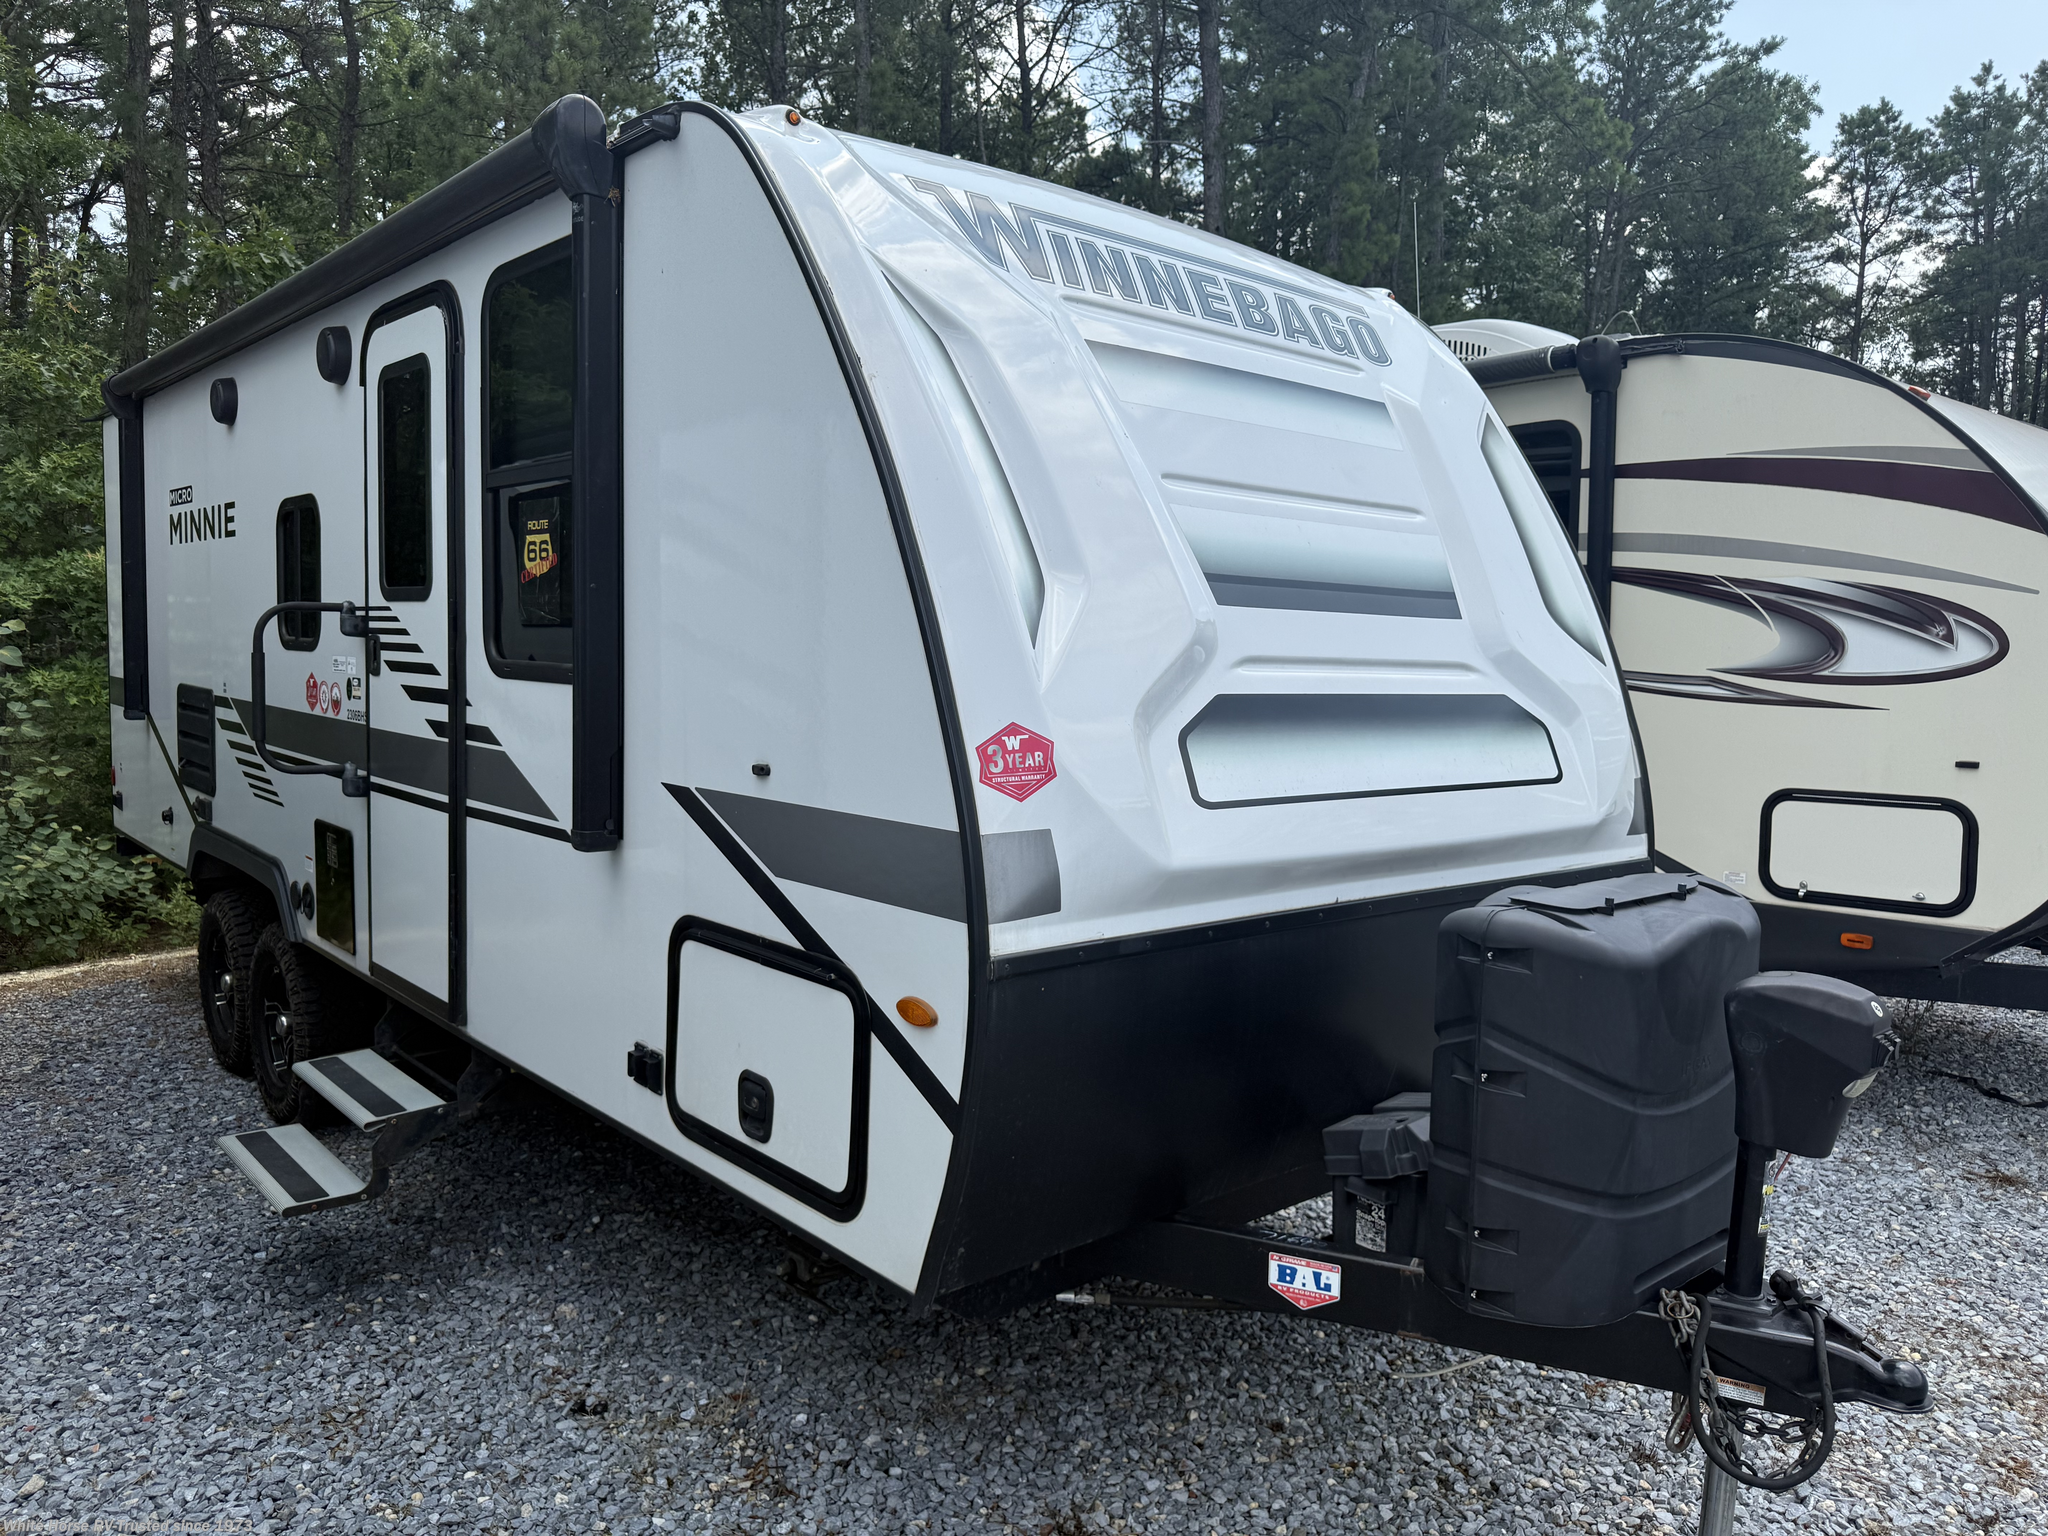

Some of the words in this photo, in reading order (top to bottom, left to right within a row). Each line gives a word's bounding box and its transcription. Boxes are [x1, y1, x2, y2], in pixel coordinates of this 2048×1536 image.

[905, 176, 1392, 367] WINNEBAGO
[170, 488, 192, 505] MICRO
[169, 501, 236, 545] MINNIE
[528, 520, 548, 530] ROUTE
[527, 540, 550, 562] 66
[521, 553, 558, 583] CERTIFIED
[987, 745, 1004, 773] 3
[1005, 752, 1044, 768] YEAR
[992, 775, 1021, 783] STRUCTURAL
[1371, 1205, 1386, 1219] 24
[1277, 1264, 1332, 1292] BAL
[1289, 1287, 1330, 1301] PRODUCTS
[1720, 1378, 1750, 1389] WARNING
